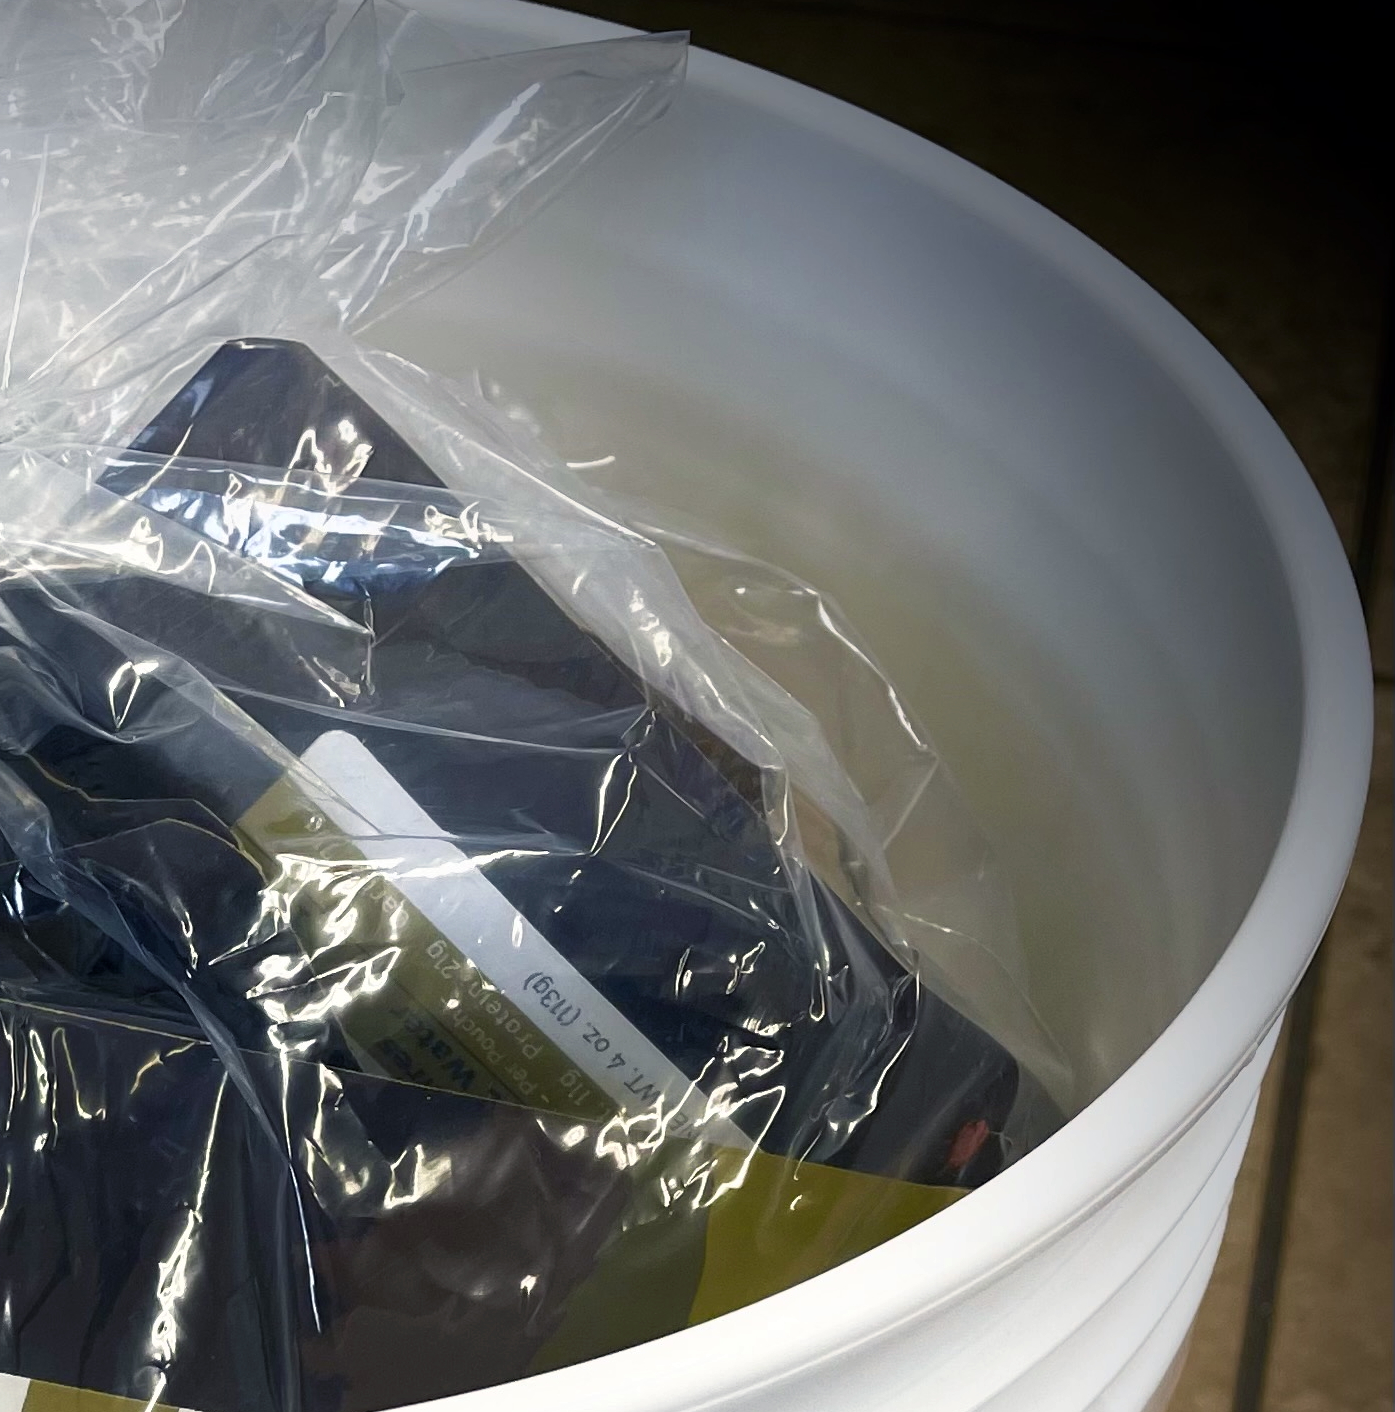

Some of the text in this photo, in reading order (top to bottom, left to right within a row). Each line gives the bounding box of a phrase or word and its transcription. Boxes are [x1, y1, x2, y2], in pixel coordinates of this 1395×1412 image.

[424, 937, 461, 980] 21g
[522, 969, 581, 1029] (113g)
[451, 1007, 506, 1066] Pouch
[580, 1020, 611, 1054] oz.
[500, 1058, 538, 1096] Per
[606, 1051, 626, 1067] 4
[558, 1069, 591, 1106] 11g
